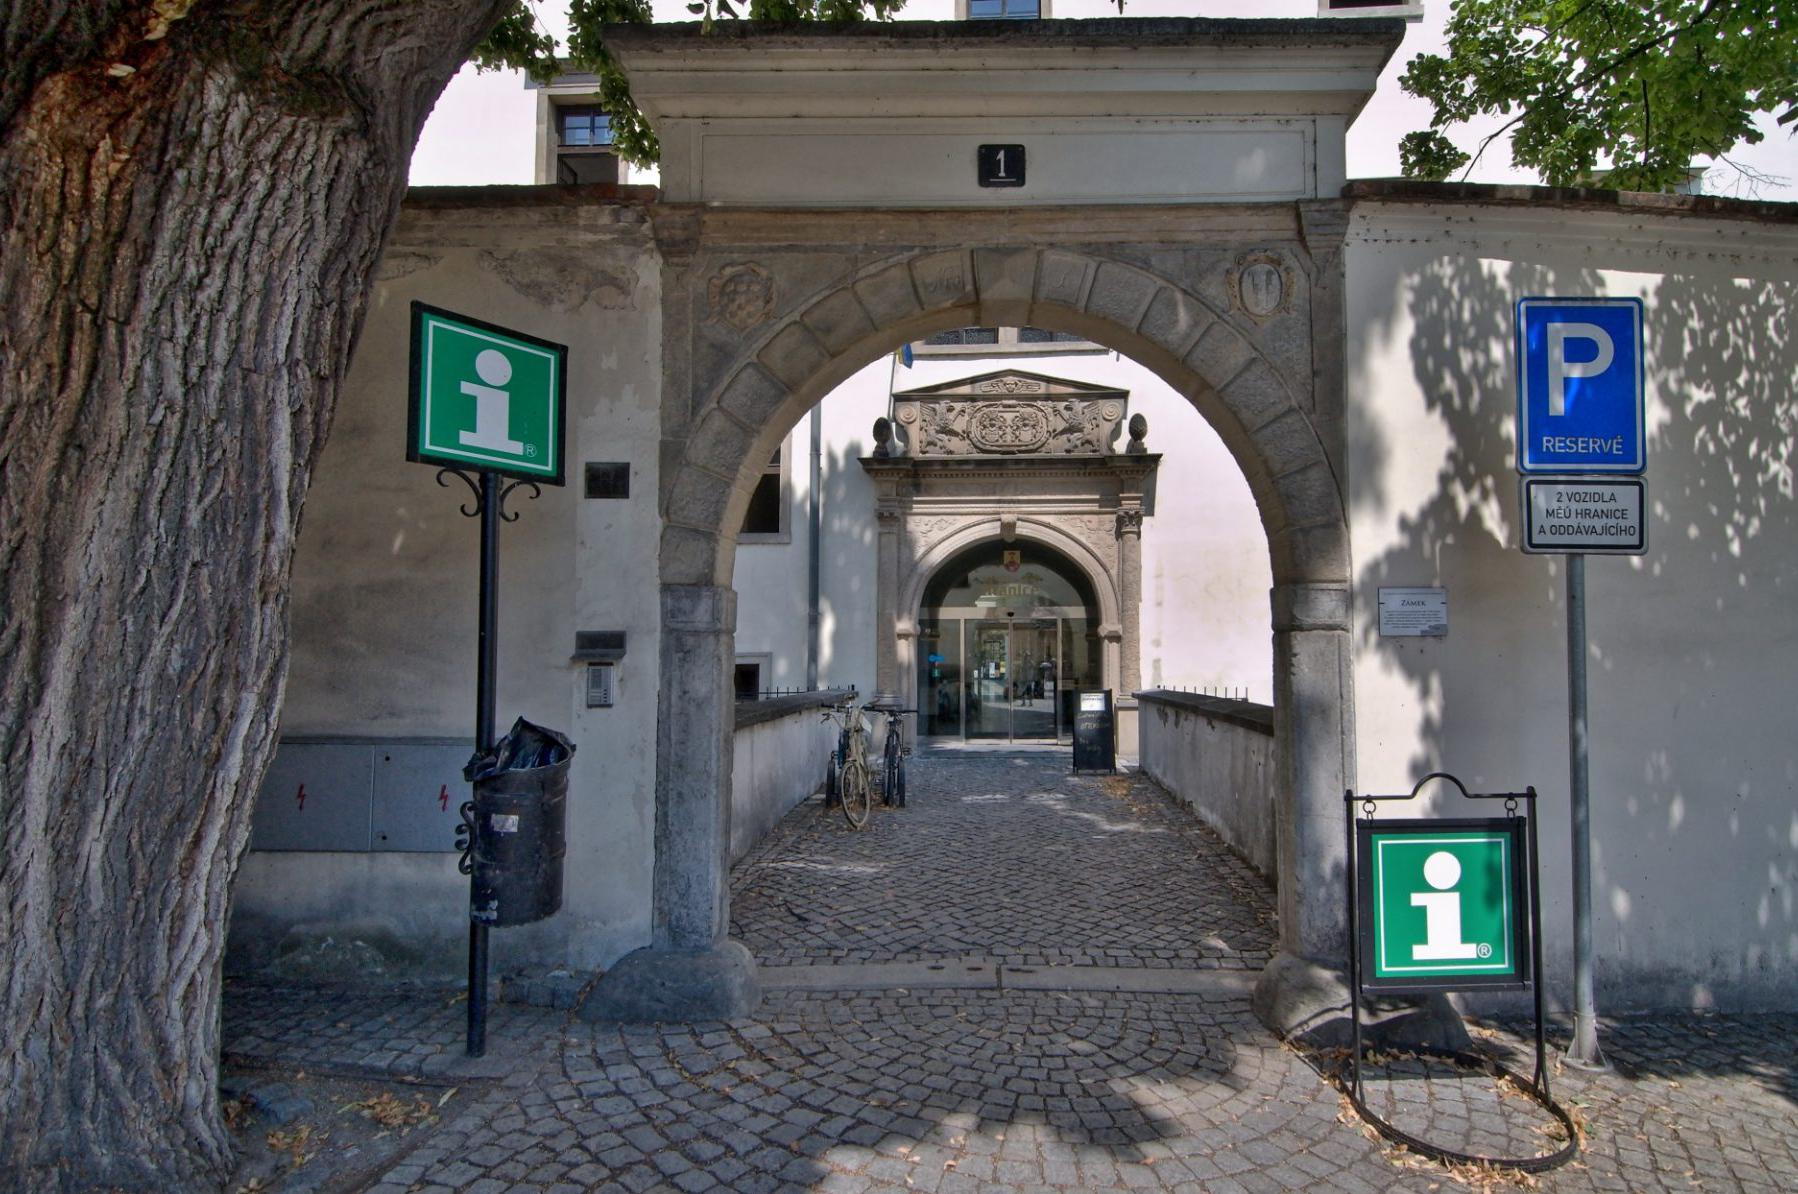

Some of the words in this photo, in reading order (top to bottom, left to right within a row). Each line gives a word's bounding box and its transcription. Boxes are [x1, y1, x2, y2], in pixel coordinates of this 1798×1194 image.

[996, 149, 1006, 177] 1
[1546, 321, 1615, 417] P
[1542, 435, 1624, 455] RESERVÉ
[1556, 491, 1563, 503] 2
[1566, 491, 1617, 503] VOZIDLA
[1575, 508, 1629, 520] HRANICE
[1538, 524, 1546, 535] A
[1549, 522, 1637, 536] ODDÁVAJÍCÍHO
